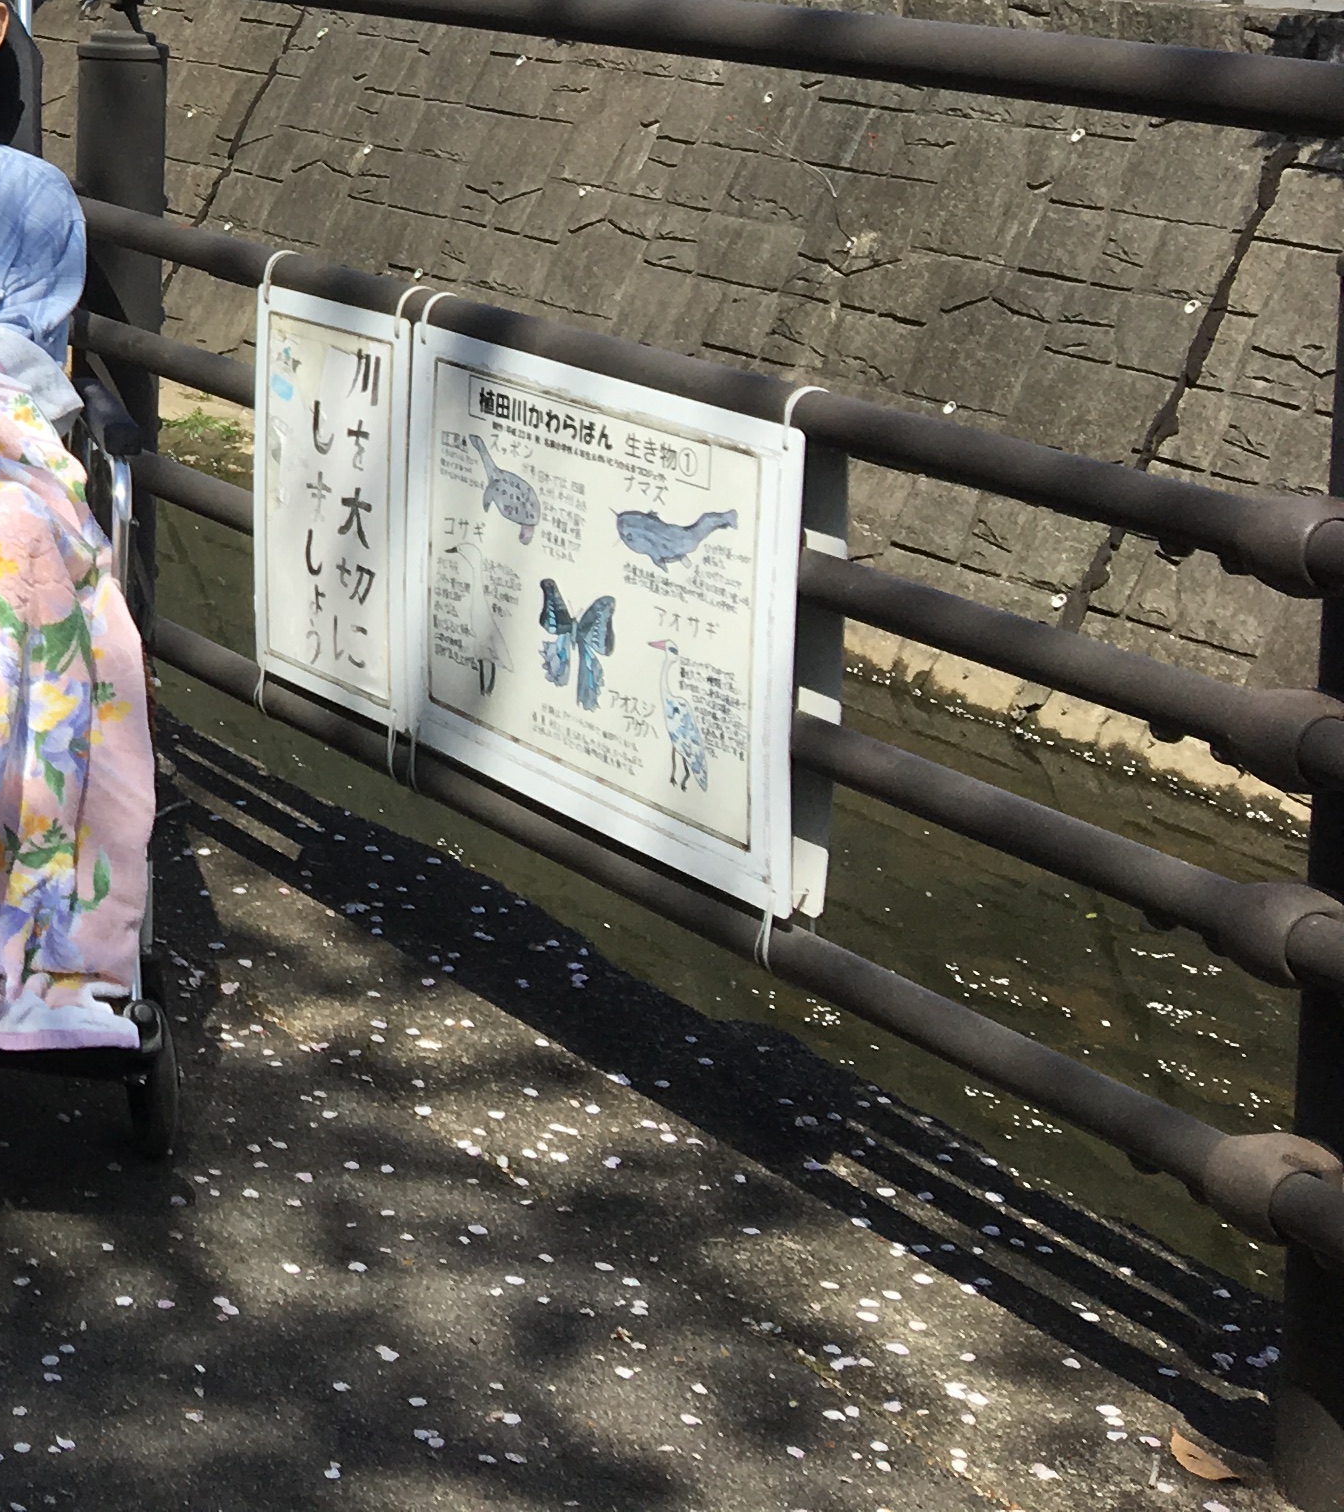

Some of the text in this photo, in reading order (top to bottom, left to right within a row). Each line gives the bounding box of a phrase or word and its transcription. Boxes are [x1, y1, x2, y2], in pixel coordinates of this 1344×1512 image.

[478, 387, 614, 450] 植田川かわらばん
[333, 348, 382, 669] 川を大切に
[624, 474, 670, 506] ナマズ
[305, 399, 335, 665] しましょう
[443, 517, 486, 543] コサギ
[653, 605, 720, 639] アオサギ
